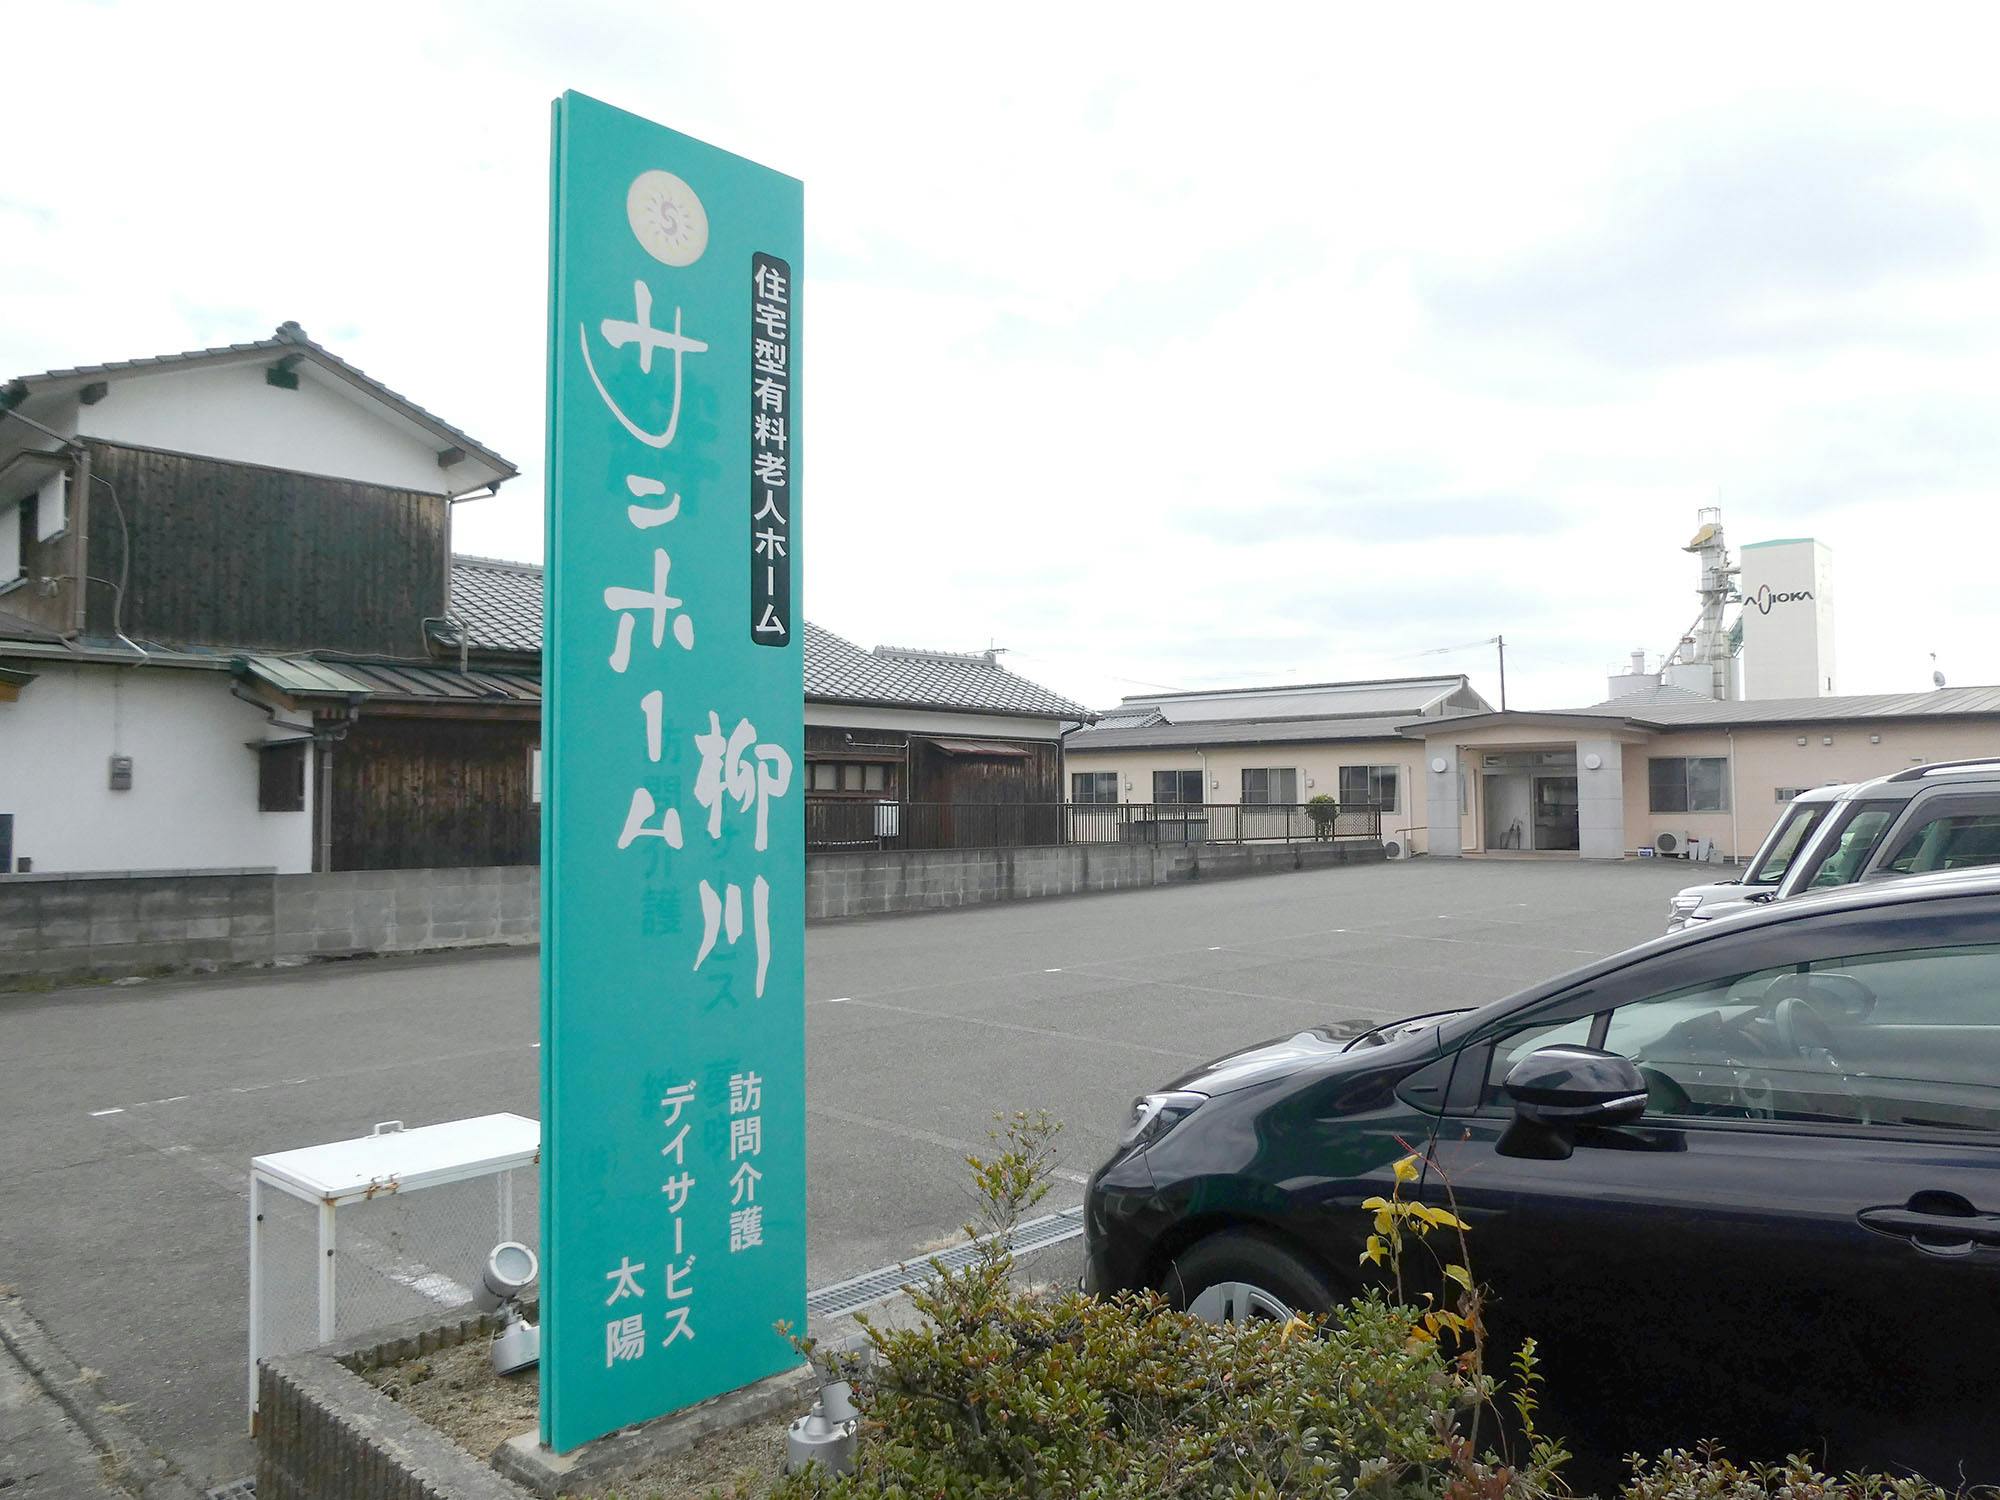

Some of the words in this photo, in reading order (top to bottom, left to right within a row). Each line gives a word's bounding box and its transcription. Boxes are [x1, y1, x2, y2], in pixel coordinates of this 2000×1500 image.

[581, 279, 709, 850] サンホーム
[754, 263, 788, 635] 住宅型有料老人ホーム
[694, 710, 793, 999] 柳川
[661, 1079, 697, 1348] デイサービス
[729, 1071, 763, 1253] 訪問介護
[606, 1256, 646, 1368] 太陽
